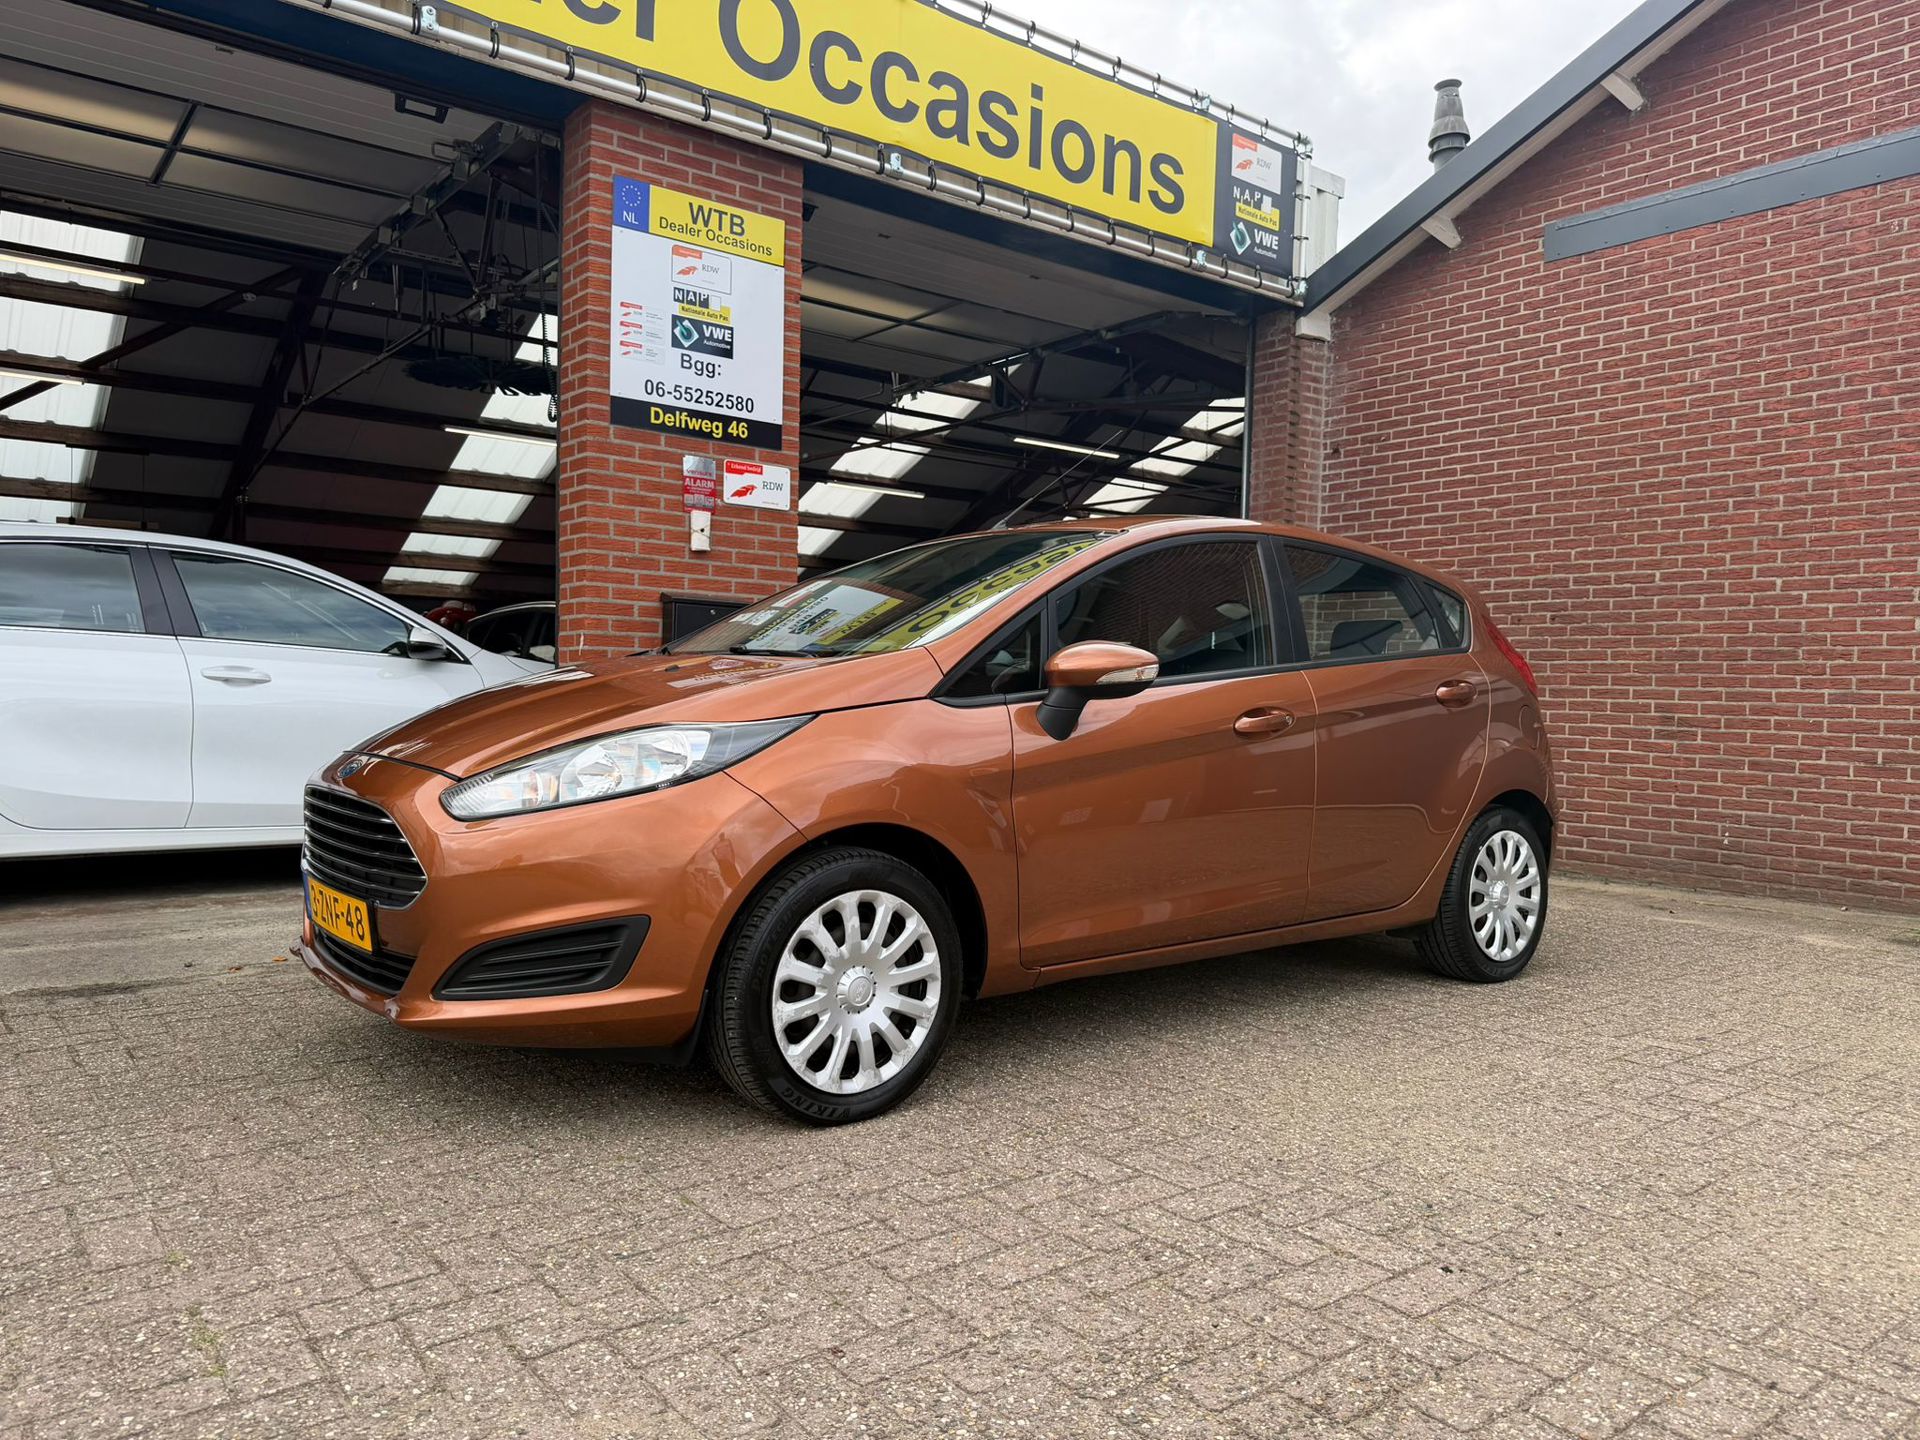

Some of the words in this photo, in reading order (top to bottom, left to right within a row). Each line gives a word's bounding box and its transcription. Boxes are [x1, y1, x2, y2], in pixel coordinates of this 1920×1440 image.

[718, 0, 1185, 214] Occasions
[622, 210, 639, 225] NL
[688, 201, 746, 238] WTB
[659, 216, 702, 238] Dealer
[706, 228, 773, 257] Occasions
[1254, 228, 1279, 250] VWE
[1253, 246, 1277, 260] Automotive
[701, 263, 720, 275] RDW
[681, 304, 706, 317] Nationale
[706, 311, 719, 321] Auto
[702, 323, 732, 342] VWE
[703, 339, 731, 350] Automotive
[680, 352, 722, 378] Bgg:
[644, 379, 754, 413] 06-55252580
[650, 406, 723, 438] Delfweg
[727, 421, 748, 438] 46
[684, 477, 715, 489] ALARM
[762, 480, 784, 492] RDW
